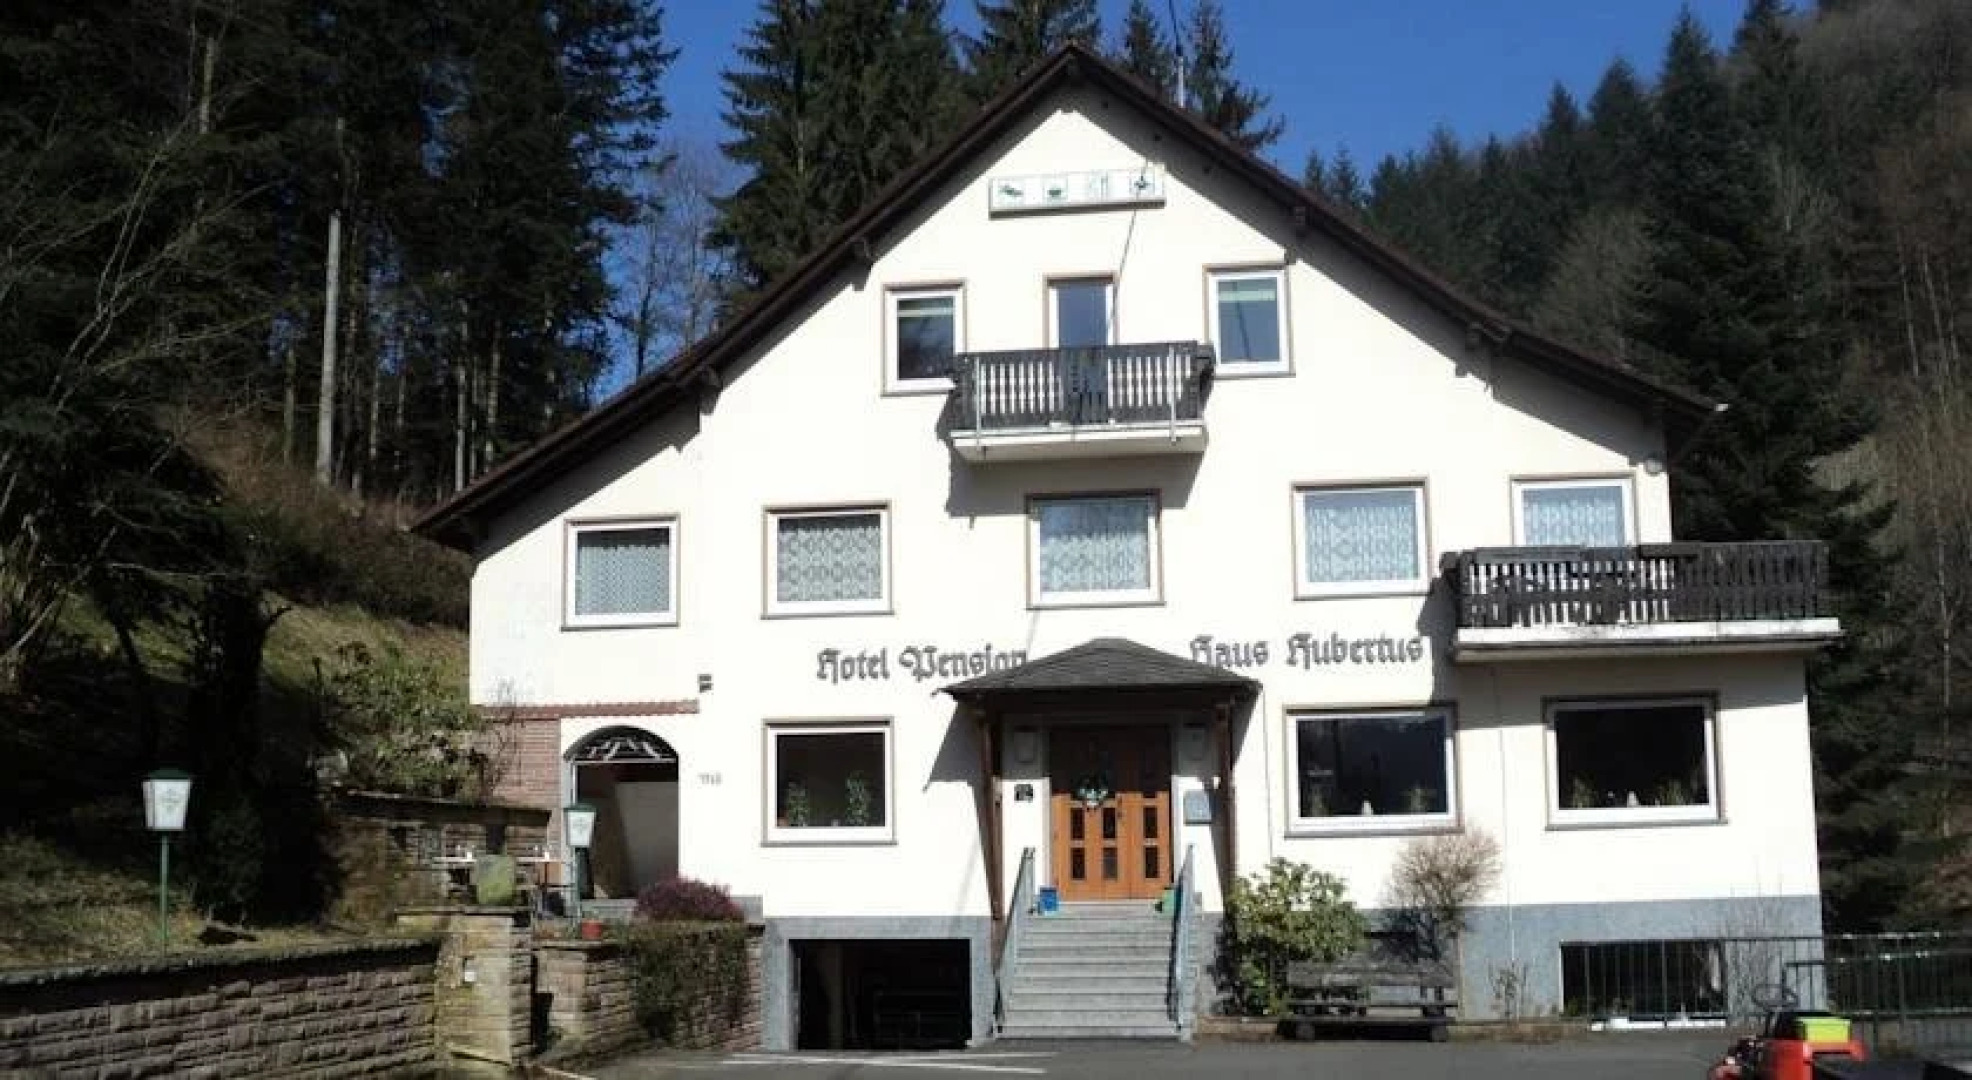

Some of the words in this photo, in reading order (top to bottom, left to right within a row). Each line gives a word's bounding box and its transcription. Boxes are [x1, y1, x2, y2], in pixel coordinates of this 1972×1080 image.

[816, 648, 890, 685] Hotel
[899, 643, 1028, 682] Pension
[1190, 634, 1269, 668] Haus
[1286, 631, 1424, 670] Hubertus
